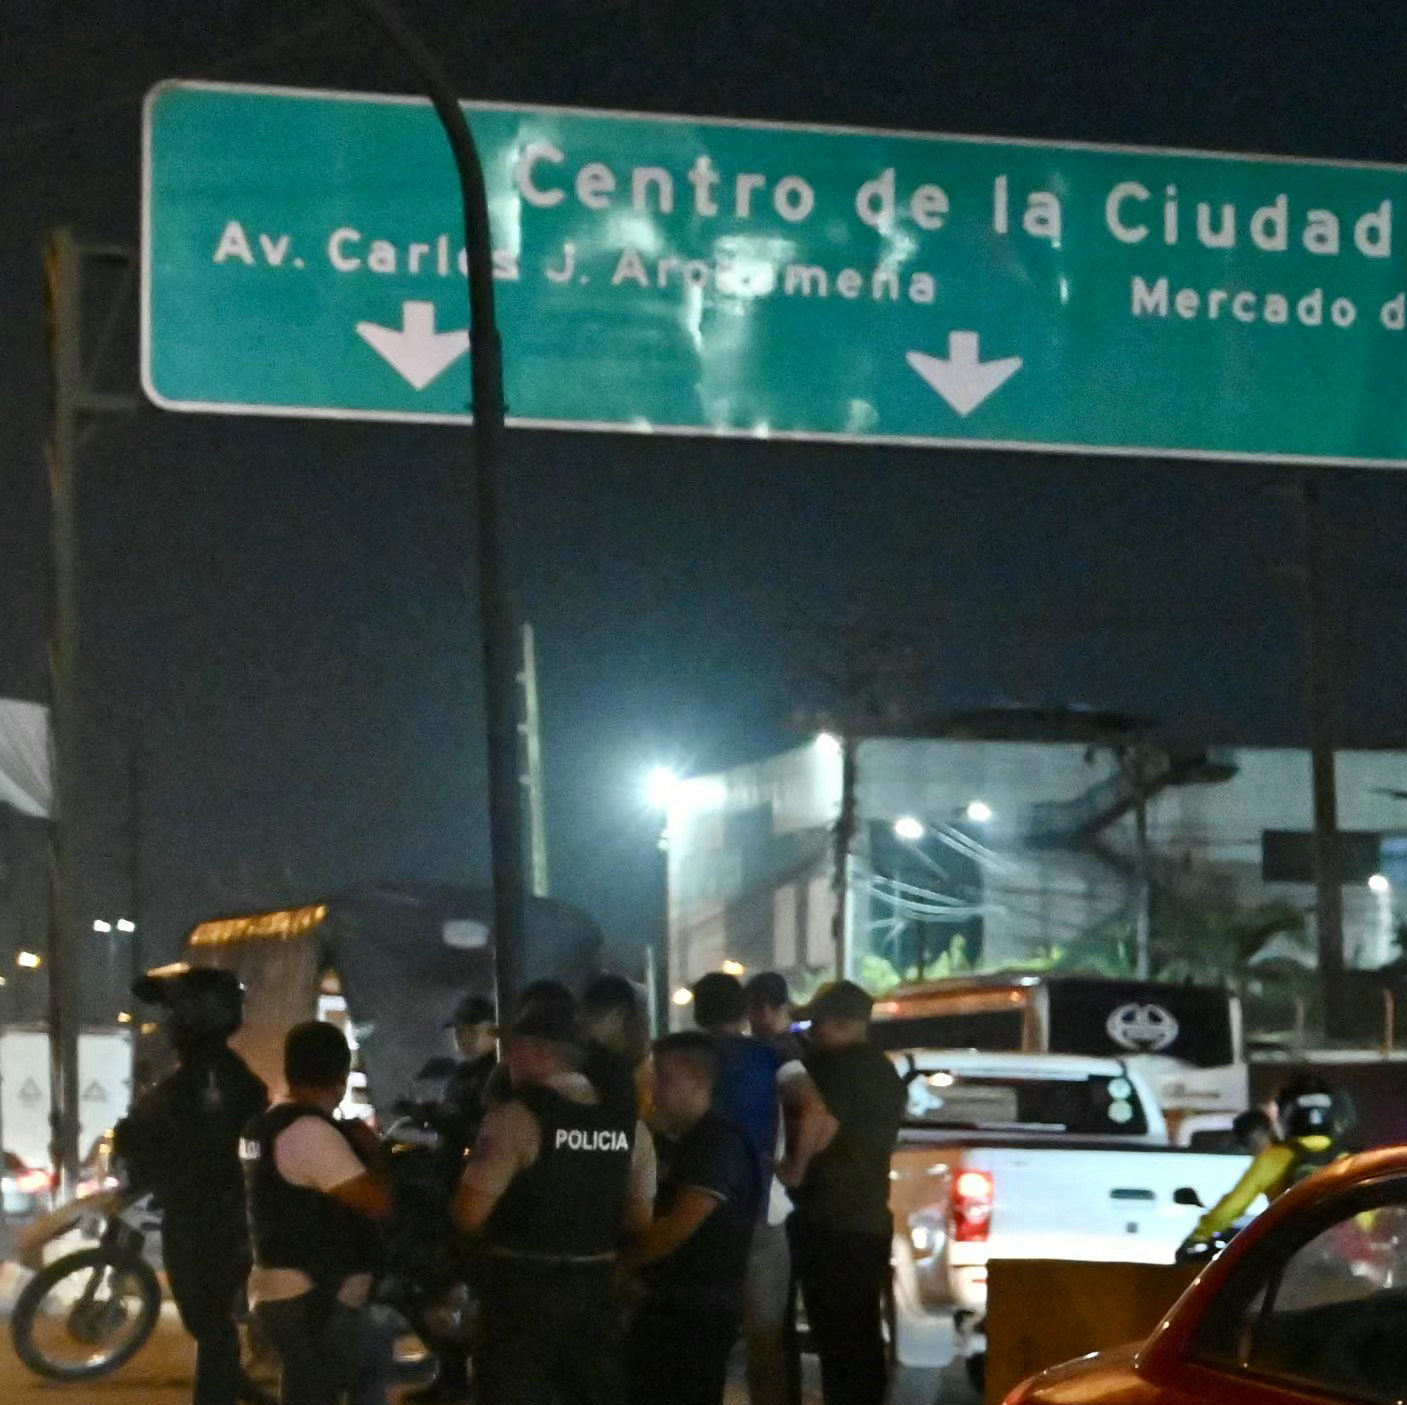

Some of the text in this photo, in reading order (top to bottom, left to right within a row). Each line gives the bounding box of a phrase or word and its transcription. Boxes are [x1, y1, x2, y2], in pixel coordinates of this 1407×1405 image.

[517, 143, 1394, 260] Centro de la Ciudad
[213, 220, 305, 268] Av.
[545, 243, 589, 284] J.
[612, 249, 935, 304] Aromena
[1130, 275, 1357, 328] Mercado
[555, 1128, 629, 1151] POLICIA
